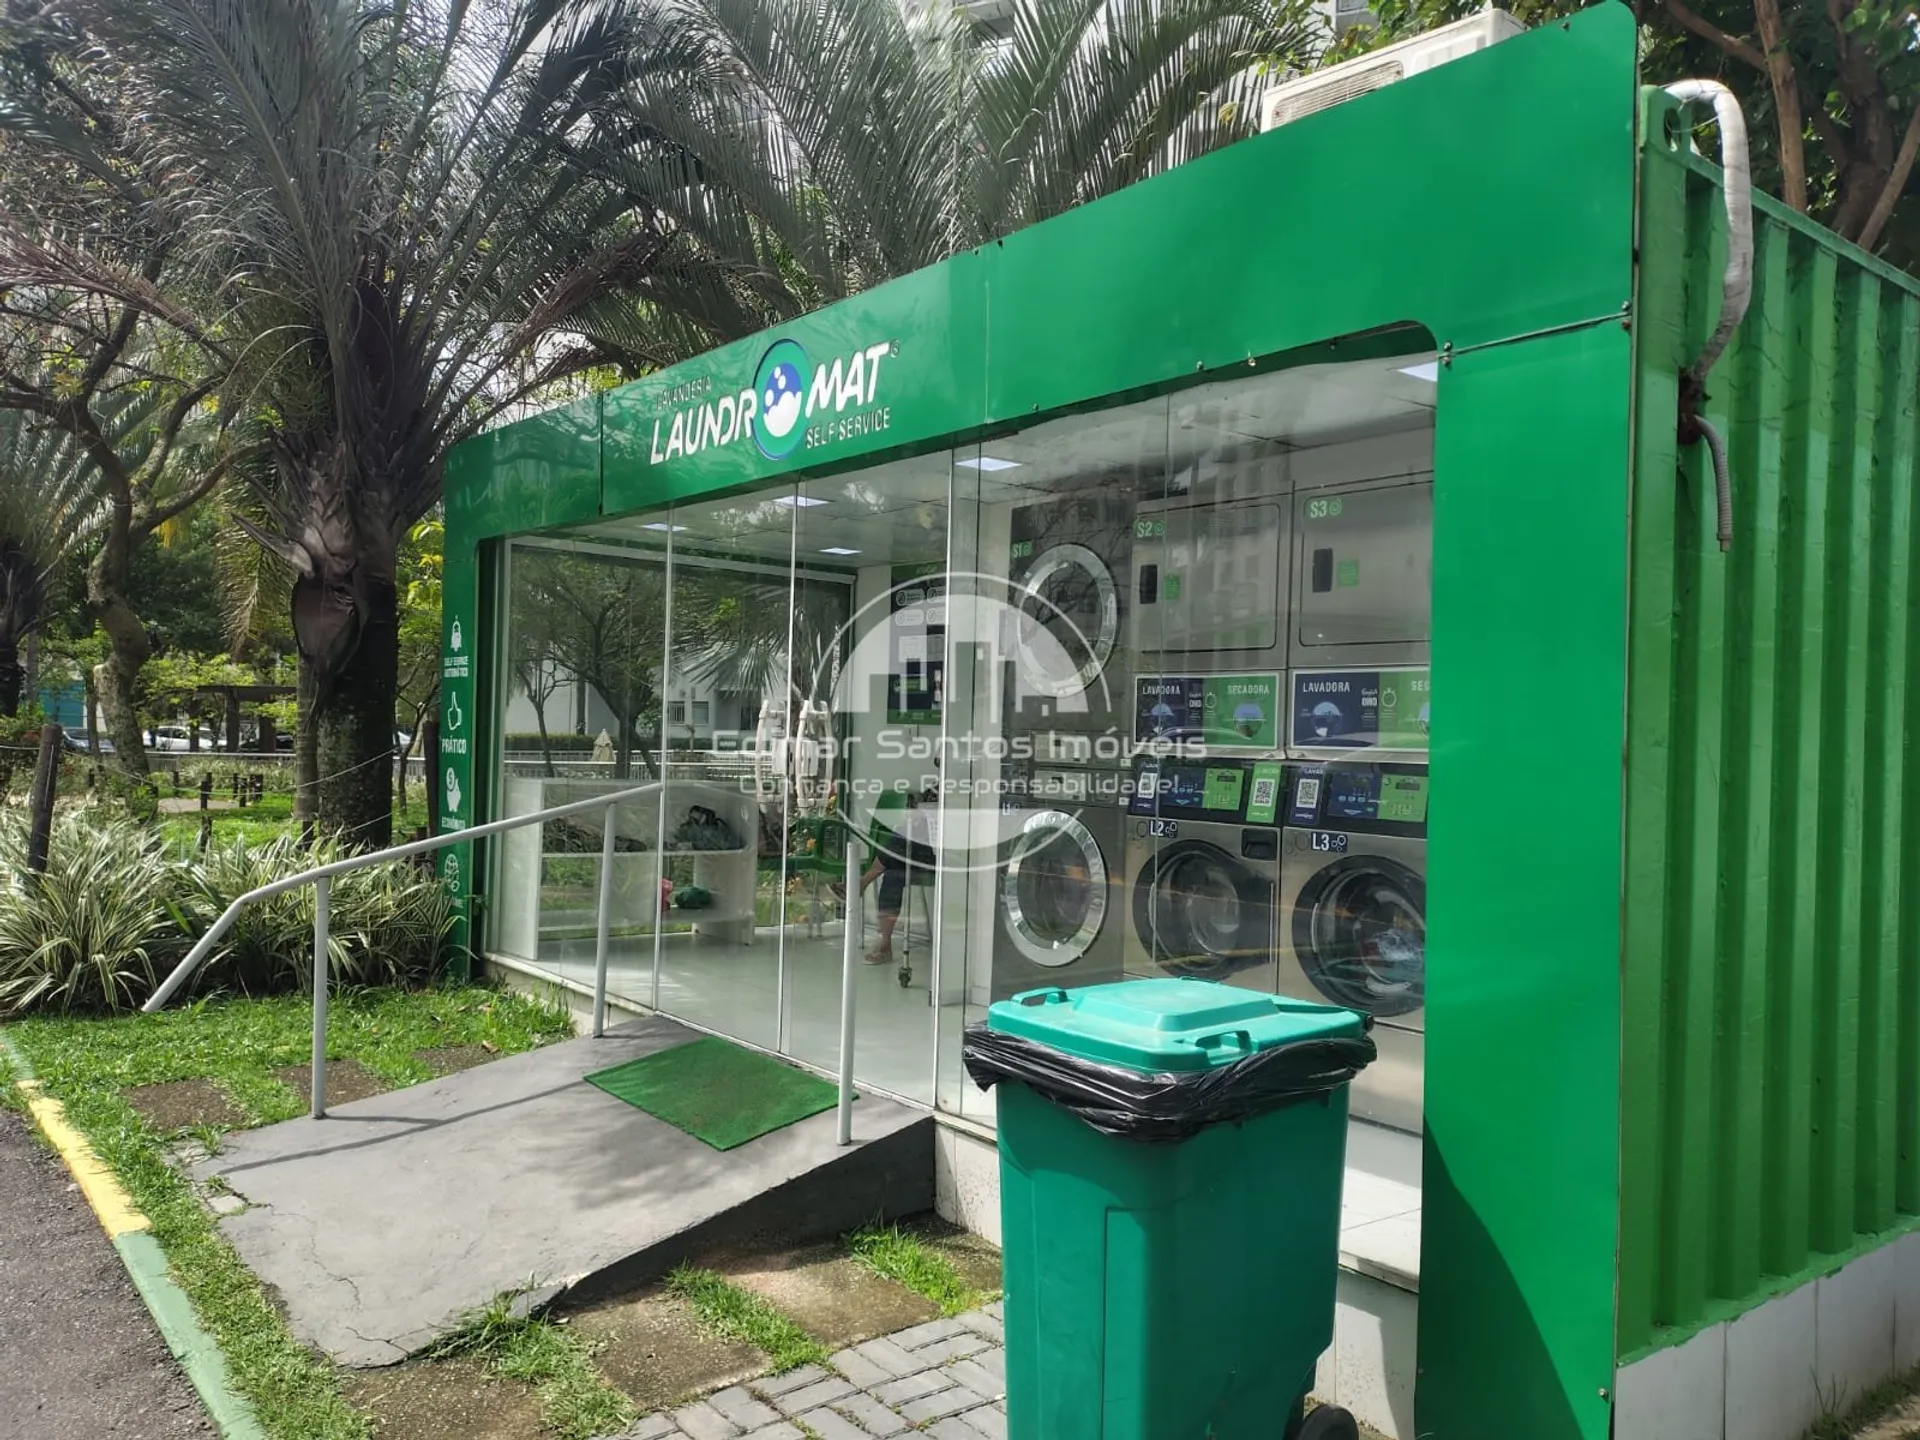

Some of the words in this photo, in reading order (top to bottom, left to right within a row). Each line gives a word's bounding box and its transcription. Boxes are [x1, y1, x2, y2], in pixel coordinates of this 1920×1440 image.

[806, 421, 835, 449] SELF
[838, 407, 891, 440] SERVICE
[1310, 500, 1328, 518] S3
[1136, 521, 1153, 538] S2
[1142, 684, 1181, 695] LAVADORA
[1303, 681, 1350, 692] LAVADORA
[442, 735, 467, 754] PRÁTICO
[1150, 820, 1164, 836] L2
[1312, 832, 1330, 851] L3
